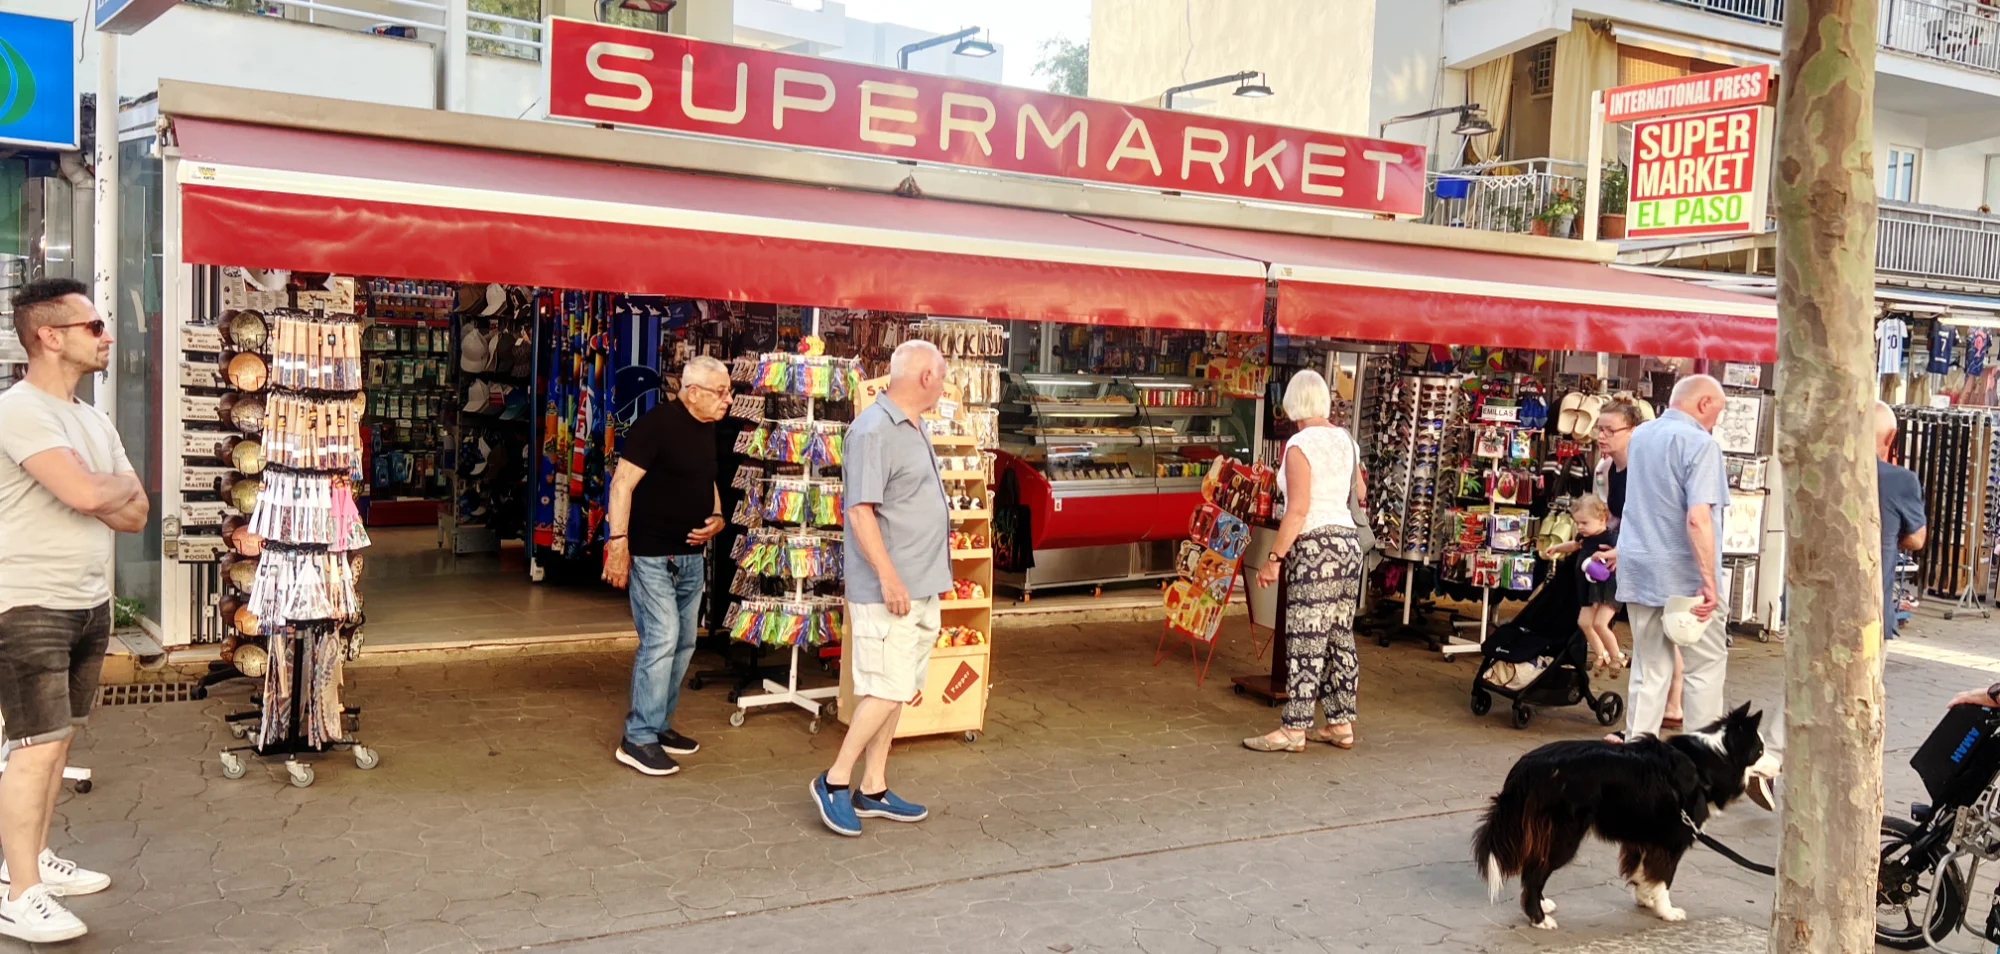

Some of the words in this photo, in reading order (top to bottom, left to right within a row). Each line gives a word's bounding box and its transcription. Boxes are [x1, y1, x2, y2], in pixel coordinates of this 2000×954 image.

[1610, 80, 1710, 116] INTERNATIONAL
[1713, 72, 1762, 102] PRESS
[585, 41, 1402, 201] SUPERMARKET
[1639, 113, 1751, 161] SUPER
[1636, 152, 1749, 198] MARKET
[1637, 201, 1665, 228] EL
[1674, 194, 1742, 225] PASO
[1941, 338, 1947, 353] 7
[1482, 408, 1513, 417] EMILLAS
[1951, 727, 1980, 763] AMAH
